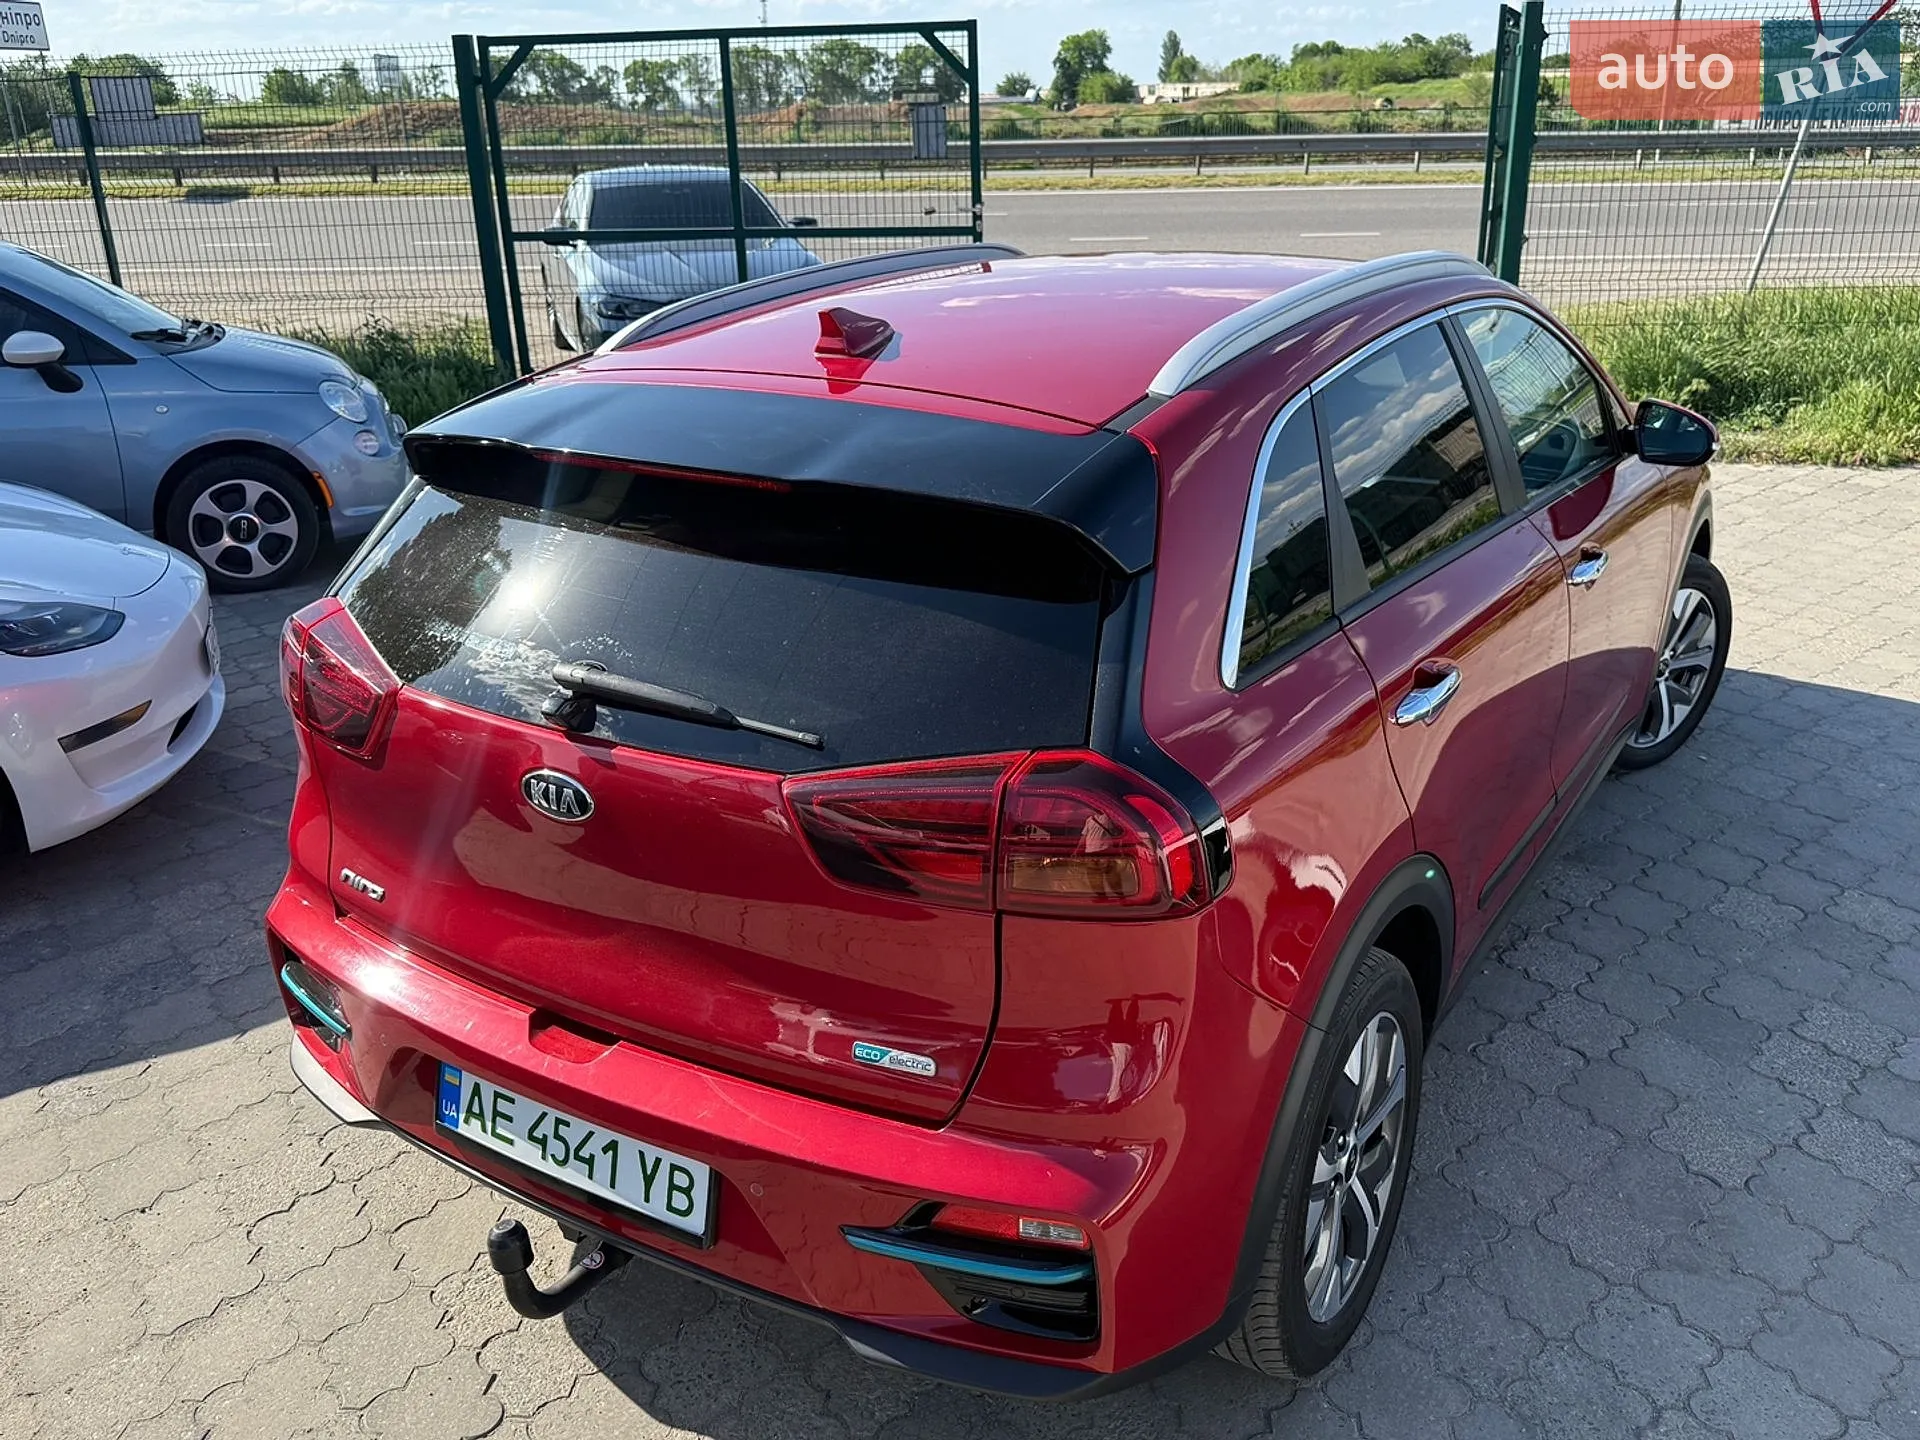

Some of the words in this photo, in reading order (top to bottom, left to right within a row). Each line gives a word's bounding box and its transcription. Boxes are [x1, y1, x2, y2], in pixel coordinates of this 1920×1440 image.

[0, 7, 41, 30] ніпро
[2, 30, 36, 46] Dnipro
[530, 778, 581, 815] KIA
[855, 1047, 880, 1060] ECO
[889, 1055, 932, 1072] electric
[442, 1099, 458, 1119] UA
[463, 1081, 516, 1146] AE
[527, 1110, 619, 1189] 4541
[638, 1150, 695, 1217] YB
